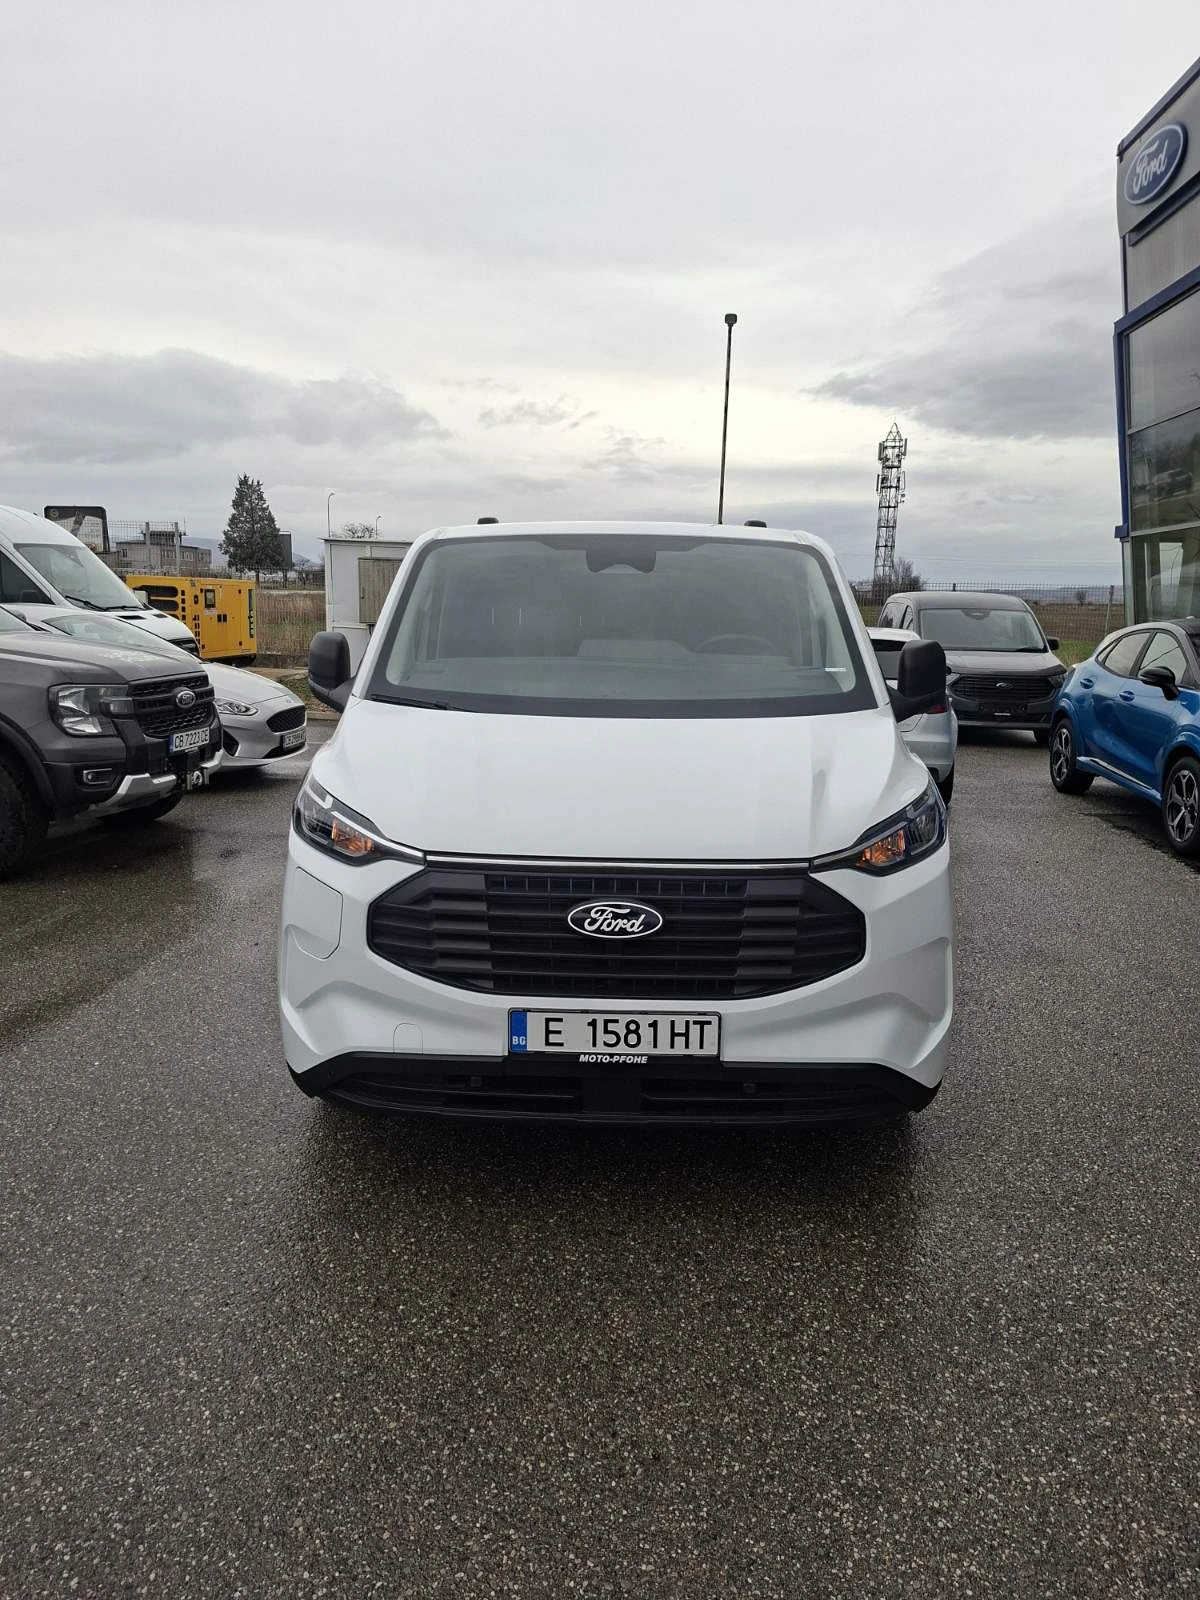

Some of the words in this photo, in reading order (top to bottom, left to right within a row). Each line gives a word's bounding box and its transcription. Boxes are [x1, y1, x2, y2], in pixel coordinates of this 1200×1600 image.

[1132, 139, 1168, 195] Ford
[584, 906, 646, 932] Ford
[512, 1036, 527, 1046] BG
[544, 1017, 564, 1047] E
[586, 1018, 659, 1049] 1581
[669, 1019, 712, 1050] HT
[579, 1054, 648, 1064] MOTO-PFOHE
